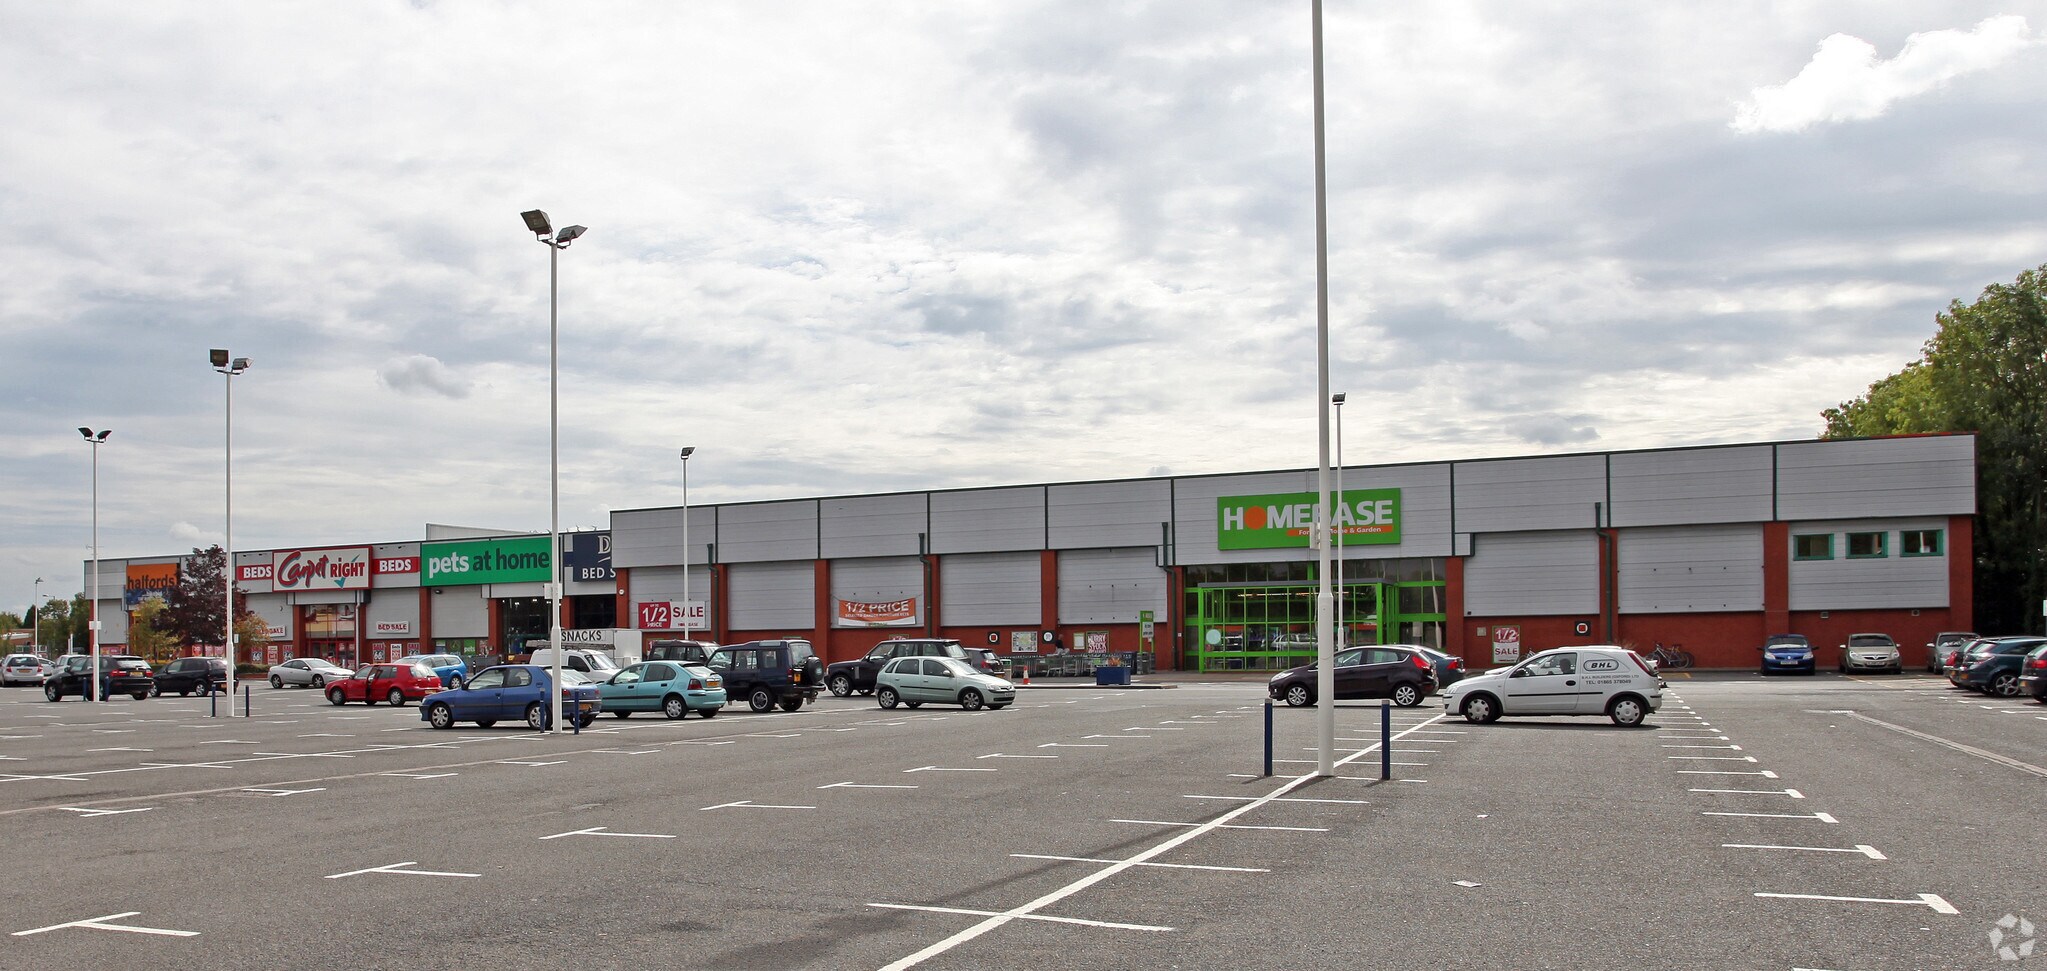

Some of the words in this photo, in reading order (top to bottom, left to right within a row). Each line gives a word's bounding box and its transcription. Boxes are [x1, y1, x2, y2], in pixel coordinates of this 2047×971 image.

[1223, 500, 1393, 530] HOMEASE
[379, 559, 412, 572] BEDS
[429, 552, 469, 578] pets
[473, 550, 491, 571] at
[496, 548, 550, 570] home
[243, 566, 272, 578] BEDS
[582, 567, 605, 579] BED
[127, 574, 175, 590] halfords
[845, 602, 866, 613] 1/2
[868, 600, 909, 613] PRICE
[643, 607, 668, 622] 1/2
[562, 630, 602, 641] SNACKS
[1496, 629, 1517, 640] 1/2
